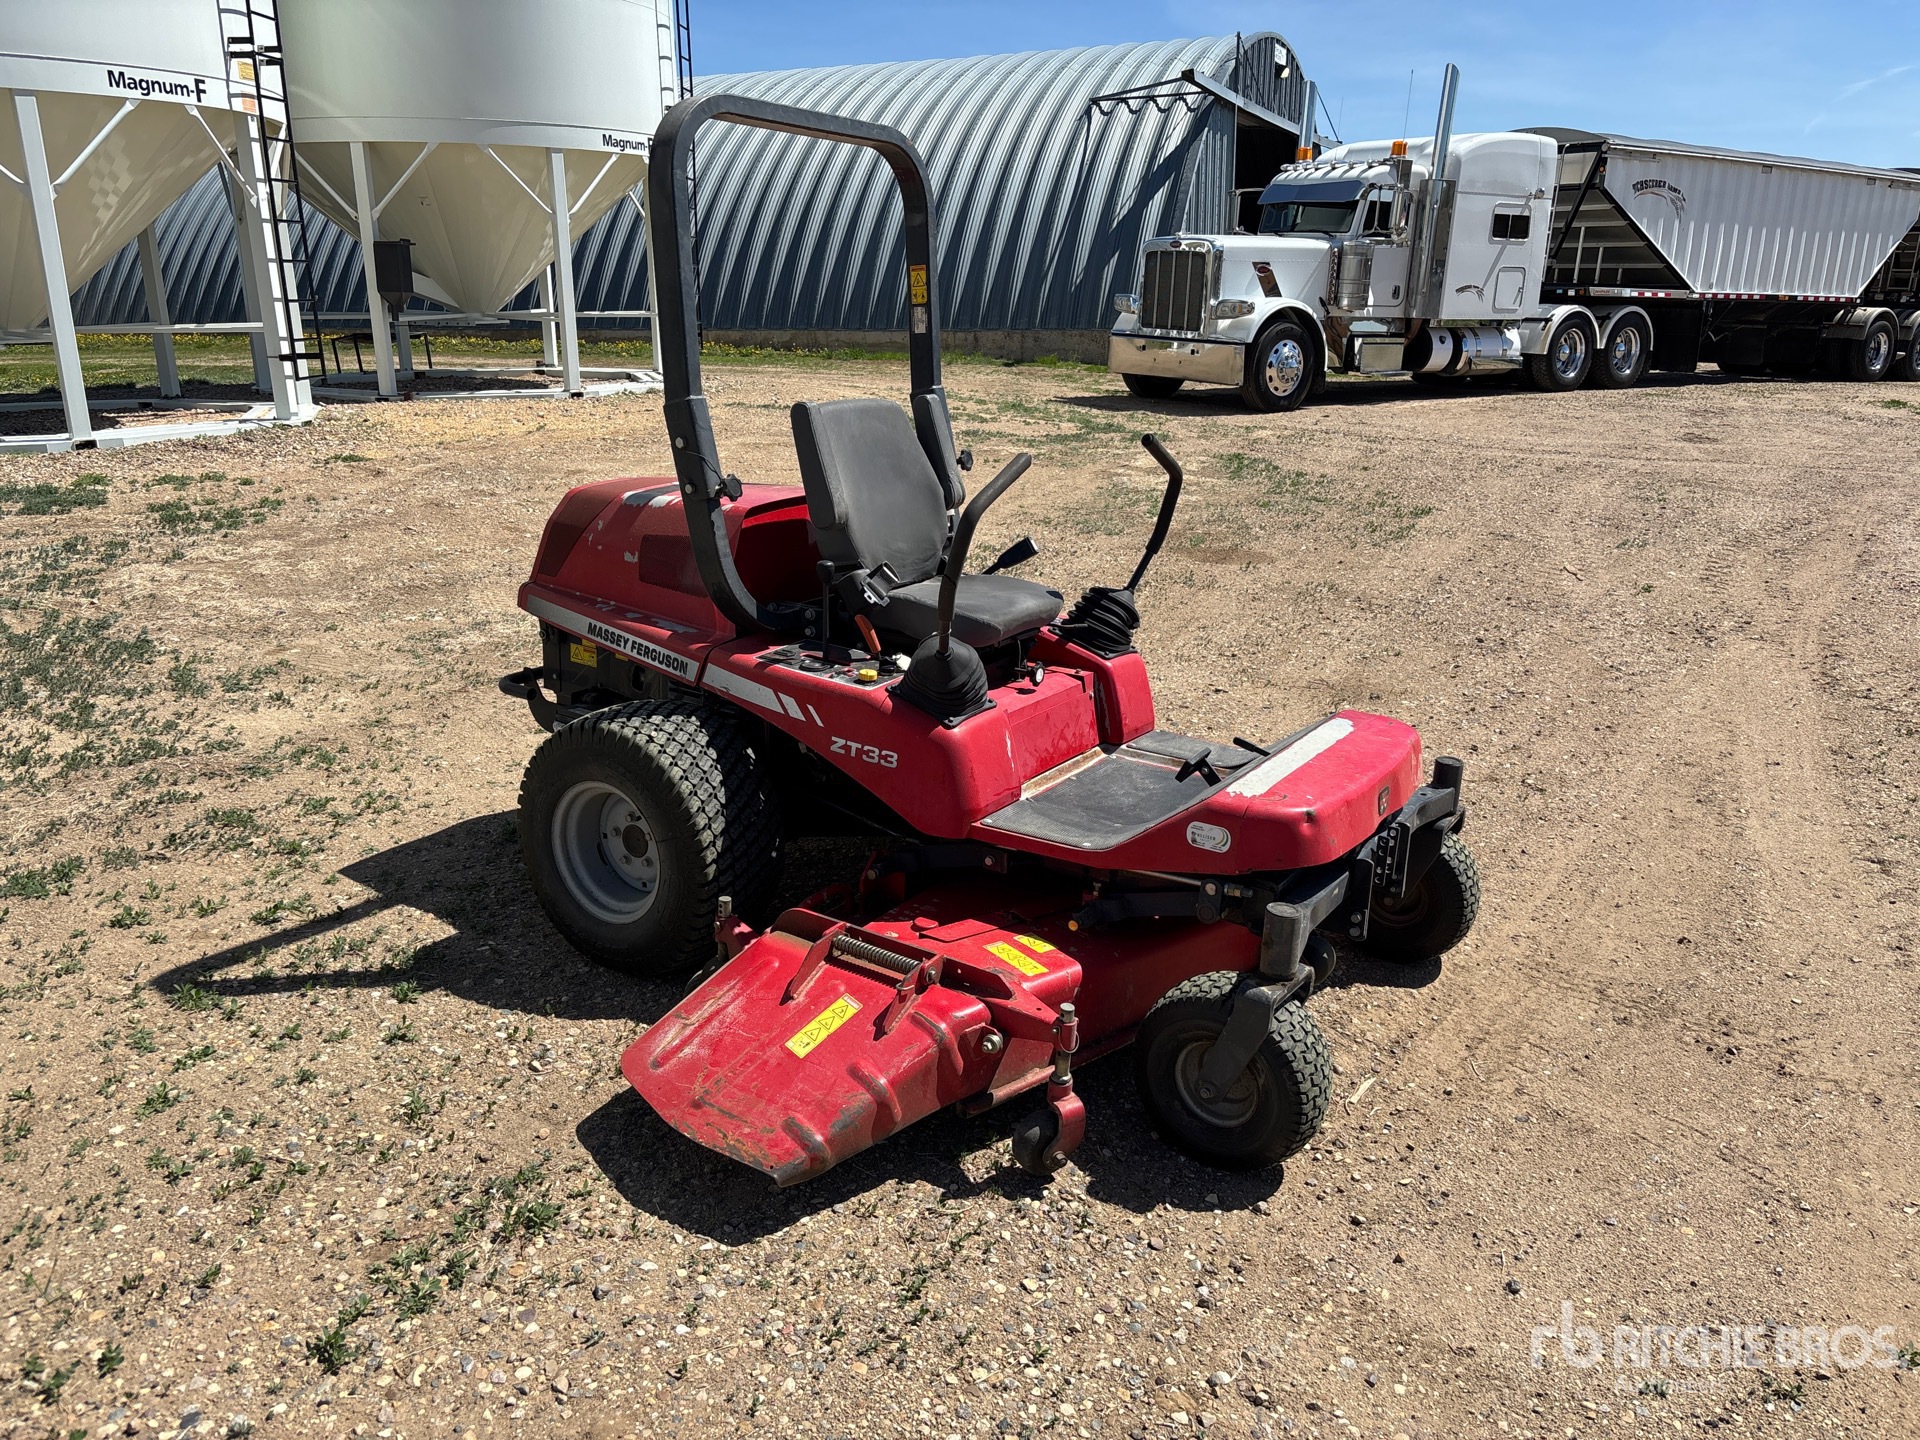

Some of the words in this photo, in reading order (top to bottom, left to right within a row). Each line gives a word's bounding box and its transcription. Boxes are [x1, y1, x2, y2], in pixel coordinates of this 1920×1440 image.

[107, 69, 207, 103] Magnum-F
[587, 621, 630, 650] MASSEY
[630, 640, 688, 675] FERGUSON
[830, 736, 898, 768] ZT33
